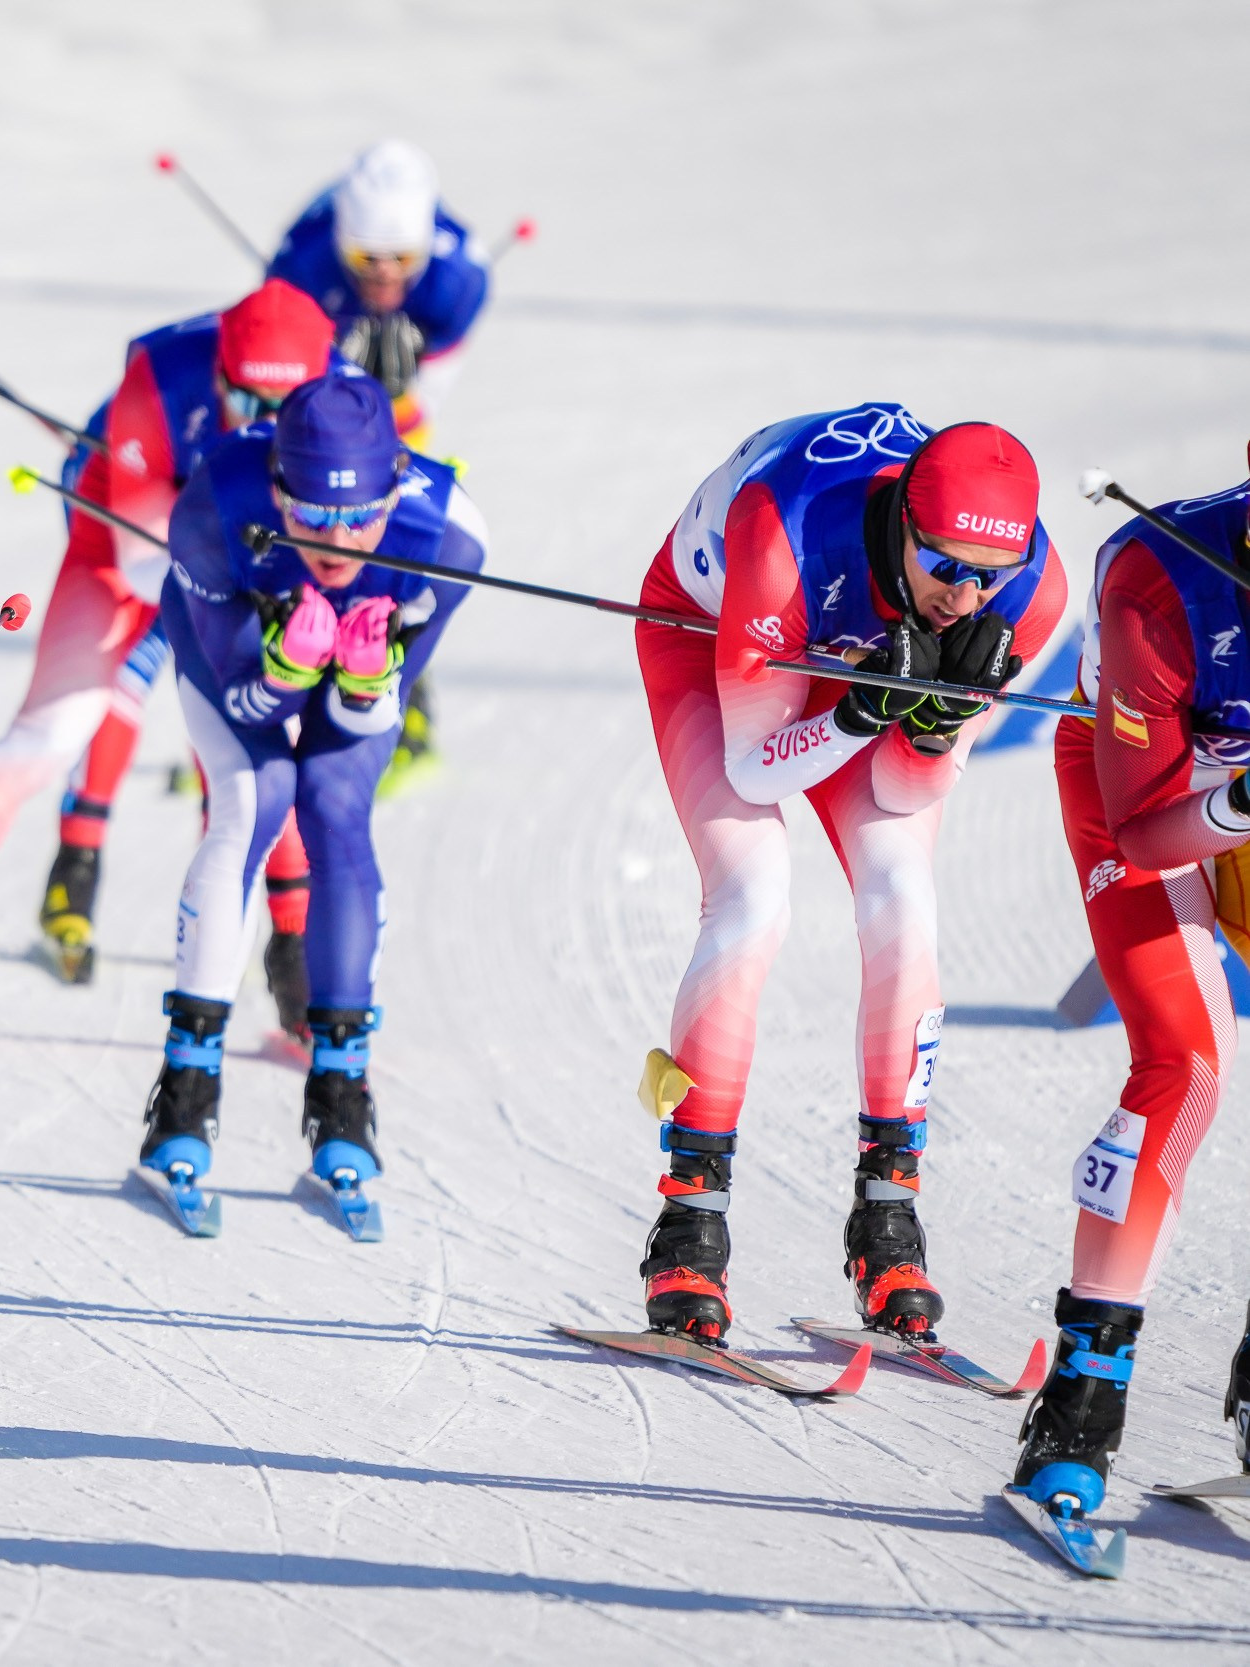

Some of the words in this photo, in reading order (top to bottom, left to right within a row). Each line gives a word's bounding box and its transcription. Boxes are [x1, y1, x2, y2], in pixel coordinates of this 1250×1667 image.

[955, 512, 1027, 541] SUISSE
[901, 630, 911, 678] Roeckl
[991, 629, 1012, 677] Roeckl
[762, 717, 832, 766] SUISSE
[1083, 1155, 1119, 1194] 37
[1096, 1205, 1116, 1217] 2022
